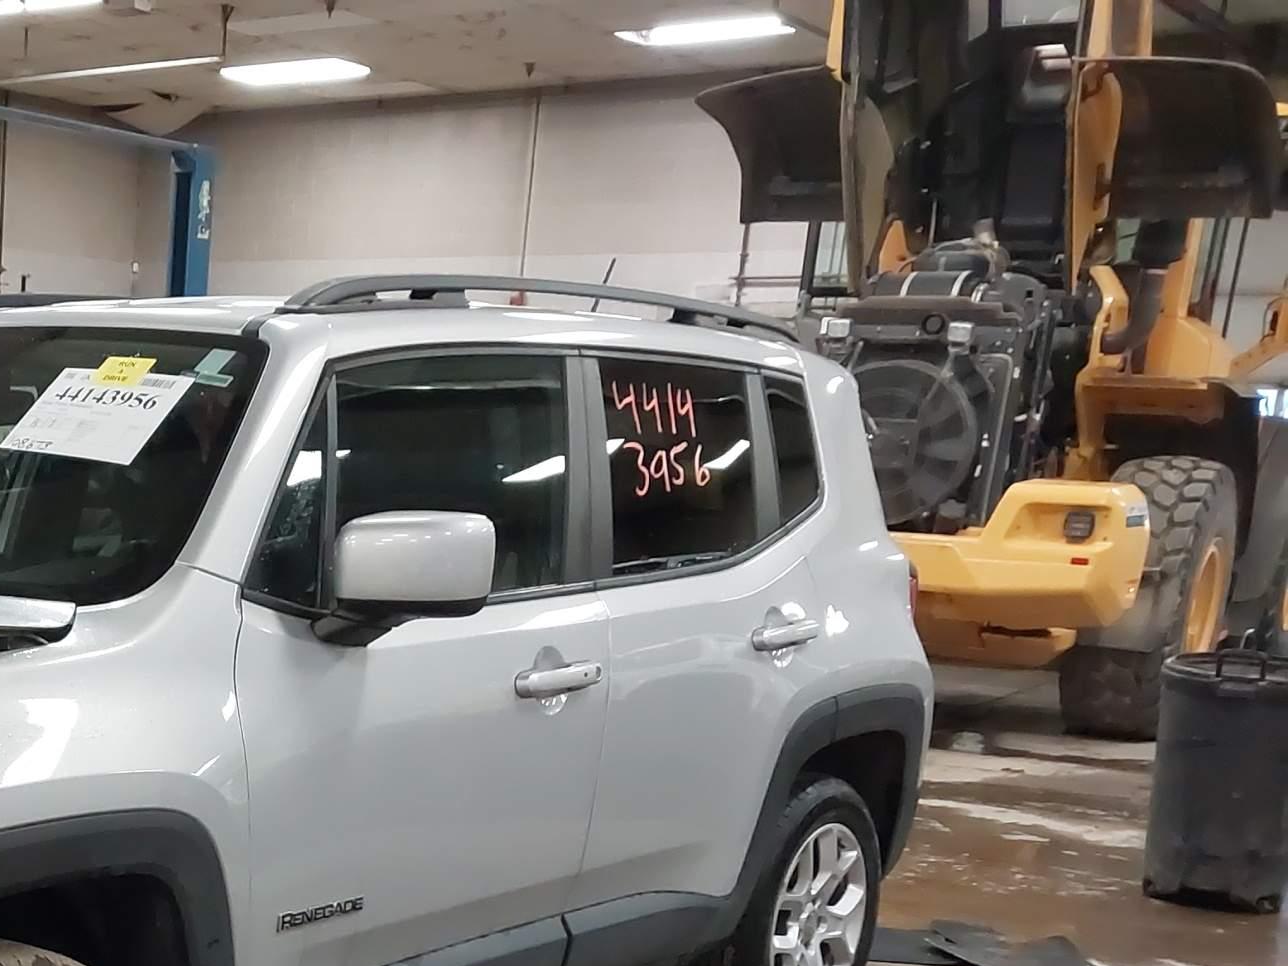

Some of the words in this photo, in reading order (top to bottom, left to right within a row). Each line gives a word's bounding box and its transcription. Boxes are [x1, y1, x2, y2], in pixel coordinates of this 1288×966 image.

[55, 385, 162, 411] 44143956
[612, 380, 697, 438] 4414
[623, 441, 711, 497] 3956
[276, 894, 365, 933] RENEGADE
